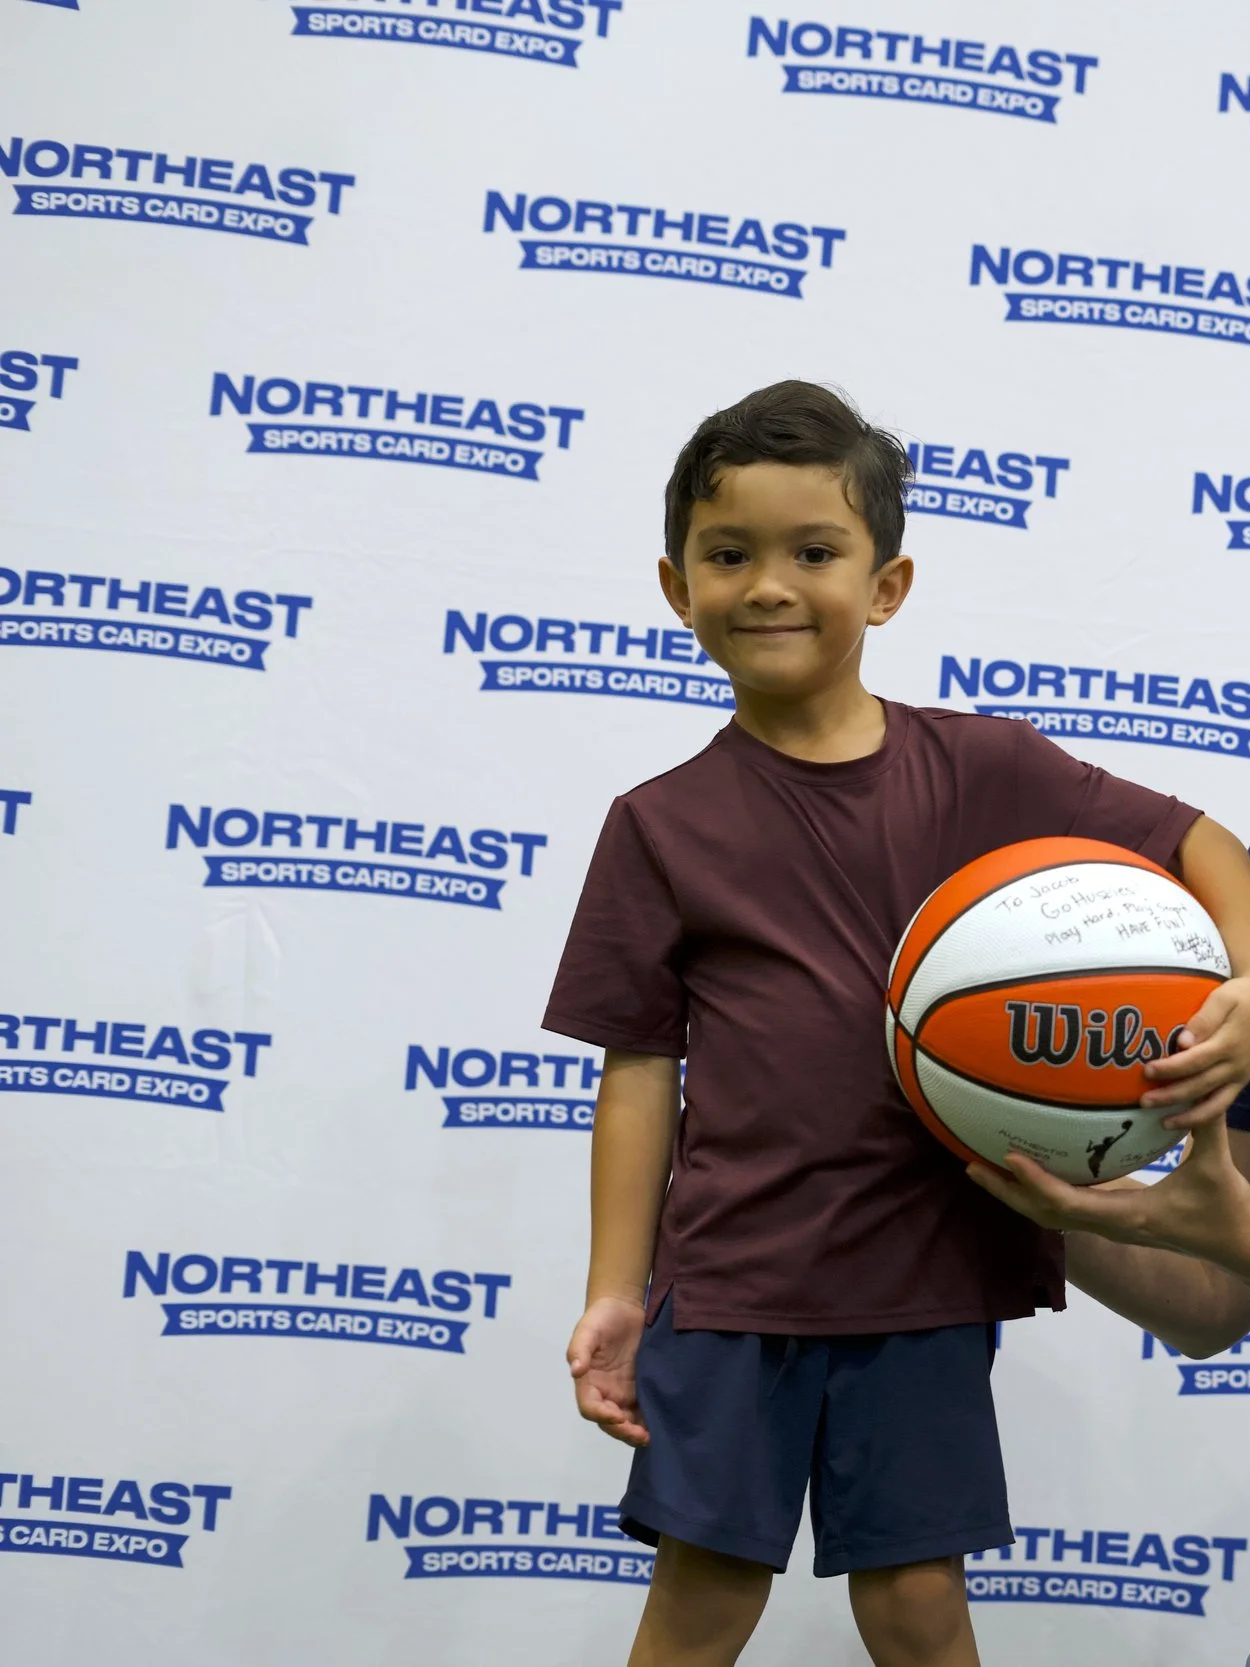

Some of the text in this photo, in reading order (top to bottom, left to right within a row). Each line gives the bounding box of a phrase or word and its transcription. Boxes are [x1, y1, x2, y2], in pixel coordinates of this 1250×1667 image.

[308, 14, 564, 59] SPORTS CARD EXPO
[747, 16, 1099, 94] NORTHEAST
[798, 70, 1044, 114] SPORTS CARD EXPO
[32, 192, 295, 237] SPORTS CARD EXPO
[483, 191, 846, 268] NORTHEAST
[536, 246, 789, 290] SPORTS CARD EXPO
[1020, 299, 1120, 321] SPORTS
[1124, 304, 1194, 329] CARD
[210, 372, 584, 449] NORTHEAST
[264, 430, 525, 472] SPORTS CARD EXPO
[946, 494, 1014, 521] EXPO
[0, 567, 312, 638] RTHEAST
[0, 621, 252, 662] PORTS CARD EXPO
[443, 610, 709, 665] NORTHE
[497, 666, 735, 704] SPORTS CARD EXP
[1098, 715, 1168, 739] CARD
[1171, 724, 1239, 750] EXPO
[167, 804, 548, 876] NORTHEAST
[222, 862, 487, 901] SPORTS CARD EXPO
[995, 876, 1079, 914] To Jacob
[1041, 902, 1071, 919] Go
[1005, 1000, 1186, 1069] Wils
[53, 1069, 131, 1092] CARD
[135, 1075, 209, 1103] EXPO
[460, 1102, 568, 1123] SPORTS
[124, 1251, 511, 1318] NORTHEAST
[179, 1309, 450, 1345] SPORTS CARD EXPO
[0, 1473, 231, 1531] HEAST
[366, 1494, 636, 1542] NORTHE
[9, 1525, 89, 1549] CARD
[93, 1532, 168, 1558] EXPO
[422, 1552, 652, 1579] SPORTS CARD EX
[966, 1576, 1191, 1609] ORTS CARD EXPO
